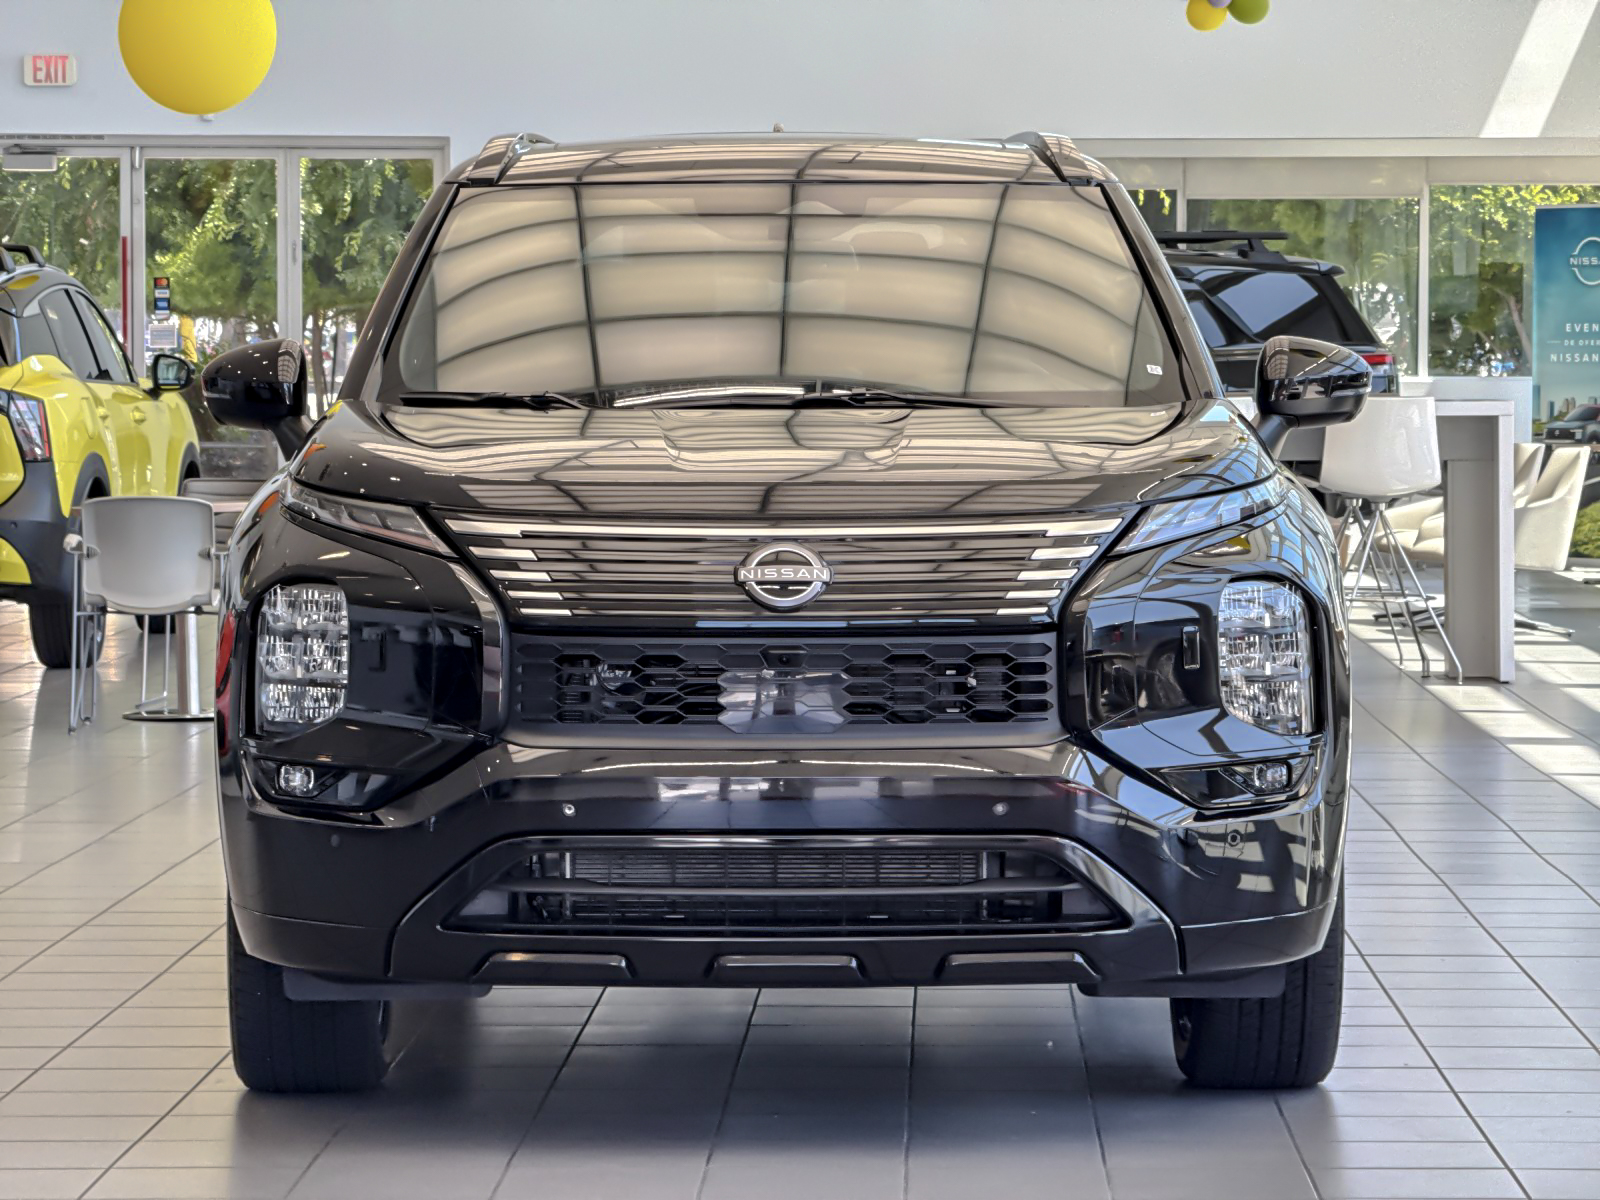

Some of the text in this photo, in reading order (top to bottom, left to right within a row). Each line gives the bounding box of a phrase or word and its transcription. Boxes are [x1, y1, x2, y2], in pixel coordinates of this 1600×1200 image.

[32, 55, 68, 84] EXIT
[1569, 256, 1600, 265] NISS
[1565, 323, 1599, 333] EVEN
[1550, 353, 1599, 362] NISSAN
[740, 568, 827, 579] NISSAN
